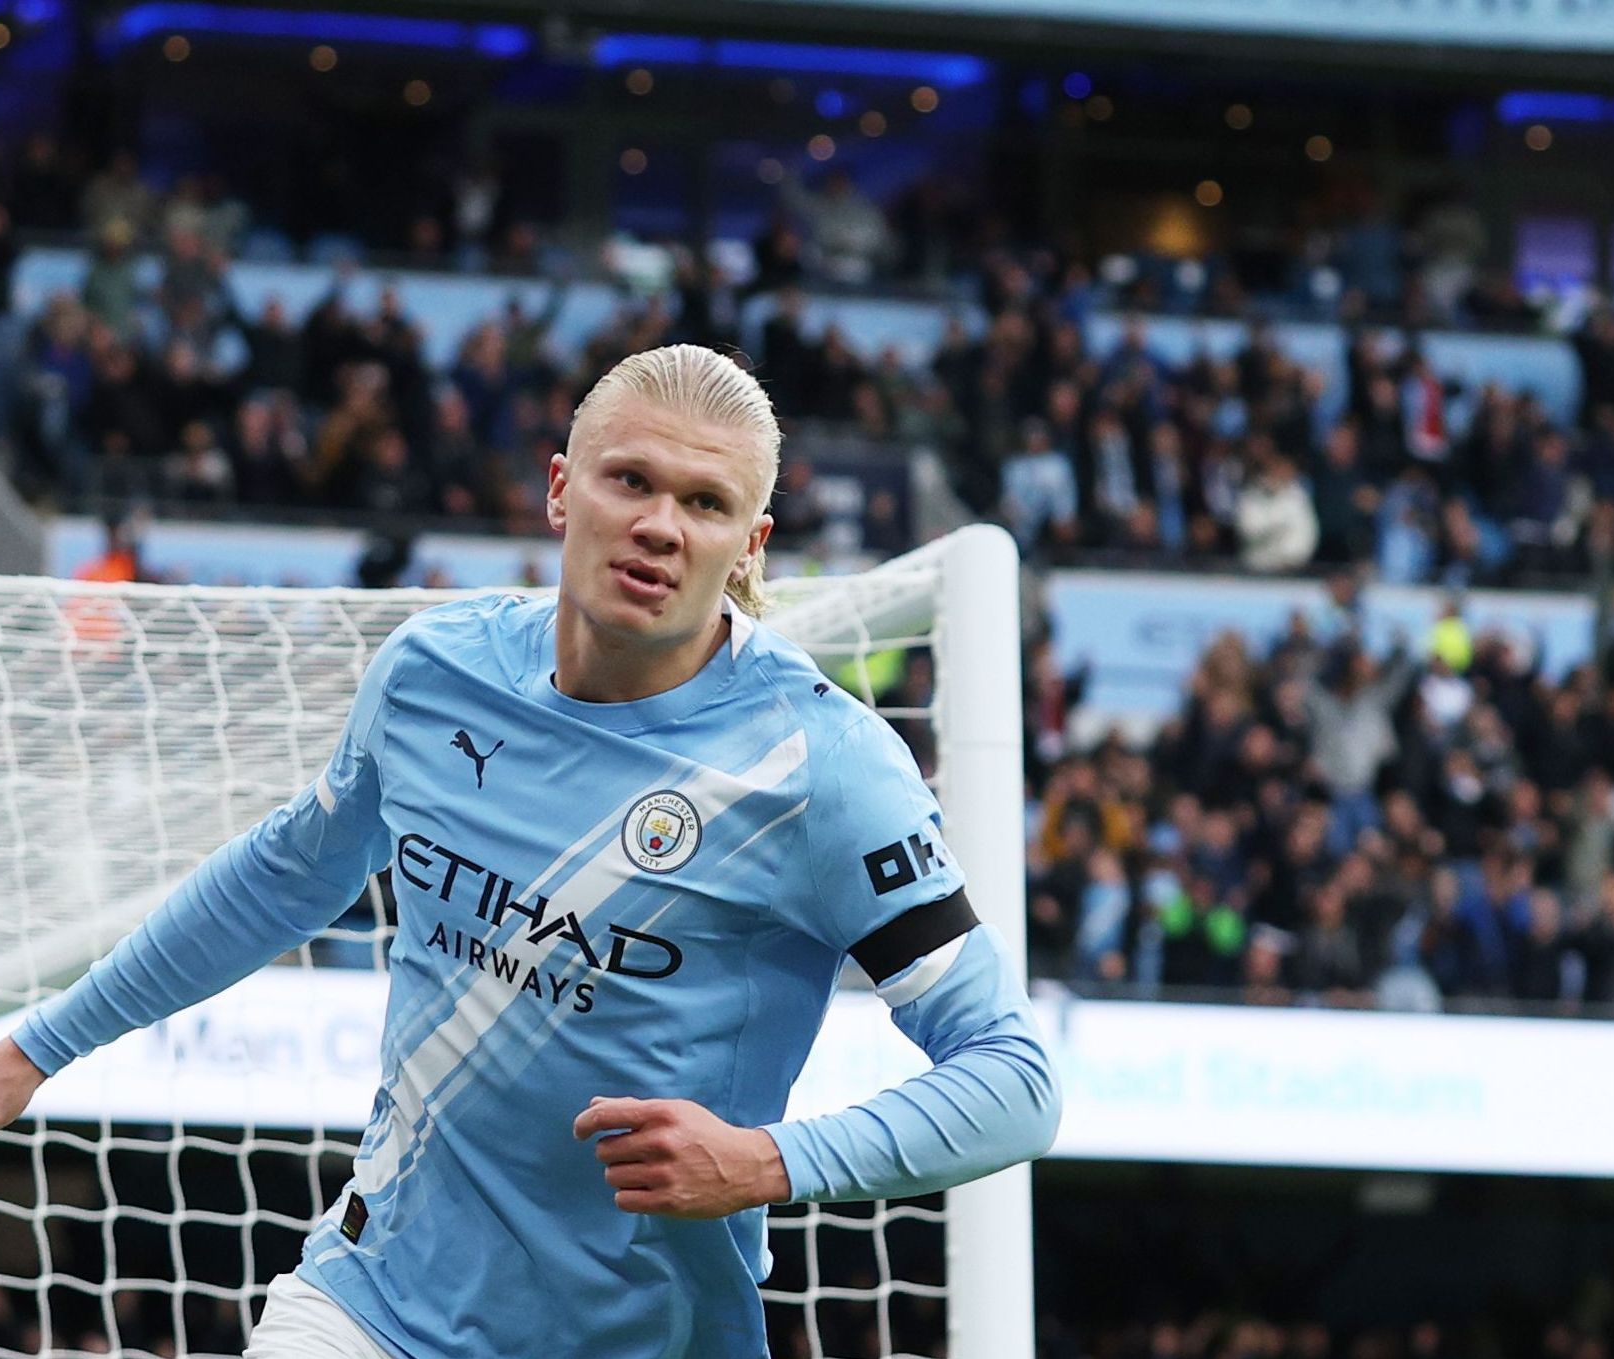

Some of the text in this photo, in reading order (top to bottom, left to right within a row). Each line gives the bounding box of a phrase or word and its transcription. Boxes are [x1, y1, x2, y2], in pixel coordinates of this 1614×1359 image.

[638, 795, 695, 831] MANCHESTER
[638, 854, 662, 868] CITY
[861, 822, 946, 896] OK
[398, 832, 683, 980] ETIHAD
[426, 921, 595, 1014] AIRWAYS
[1202, 1047, 1485, 1117] Stadium
